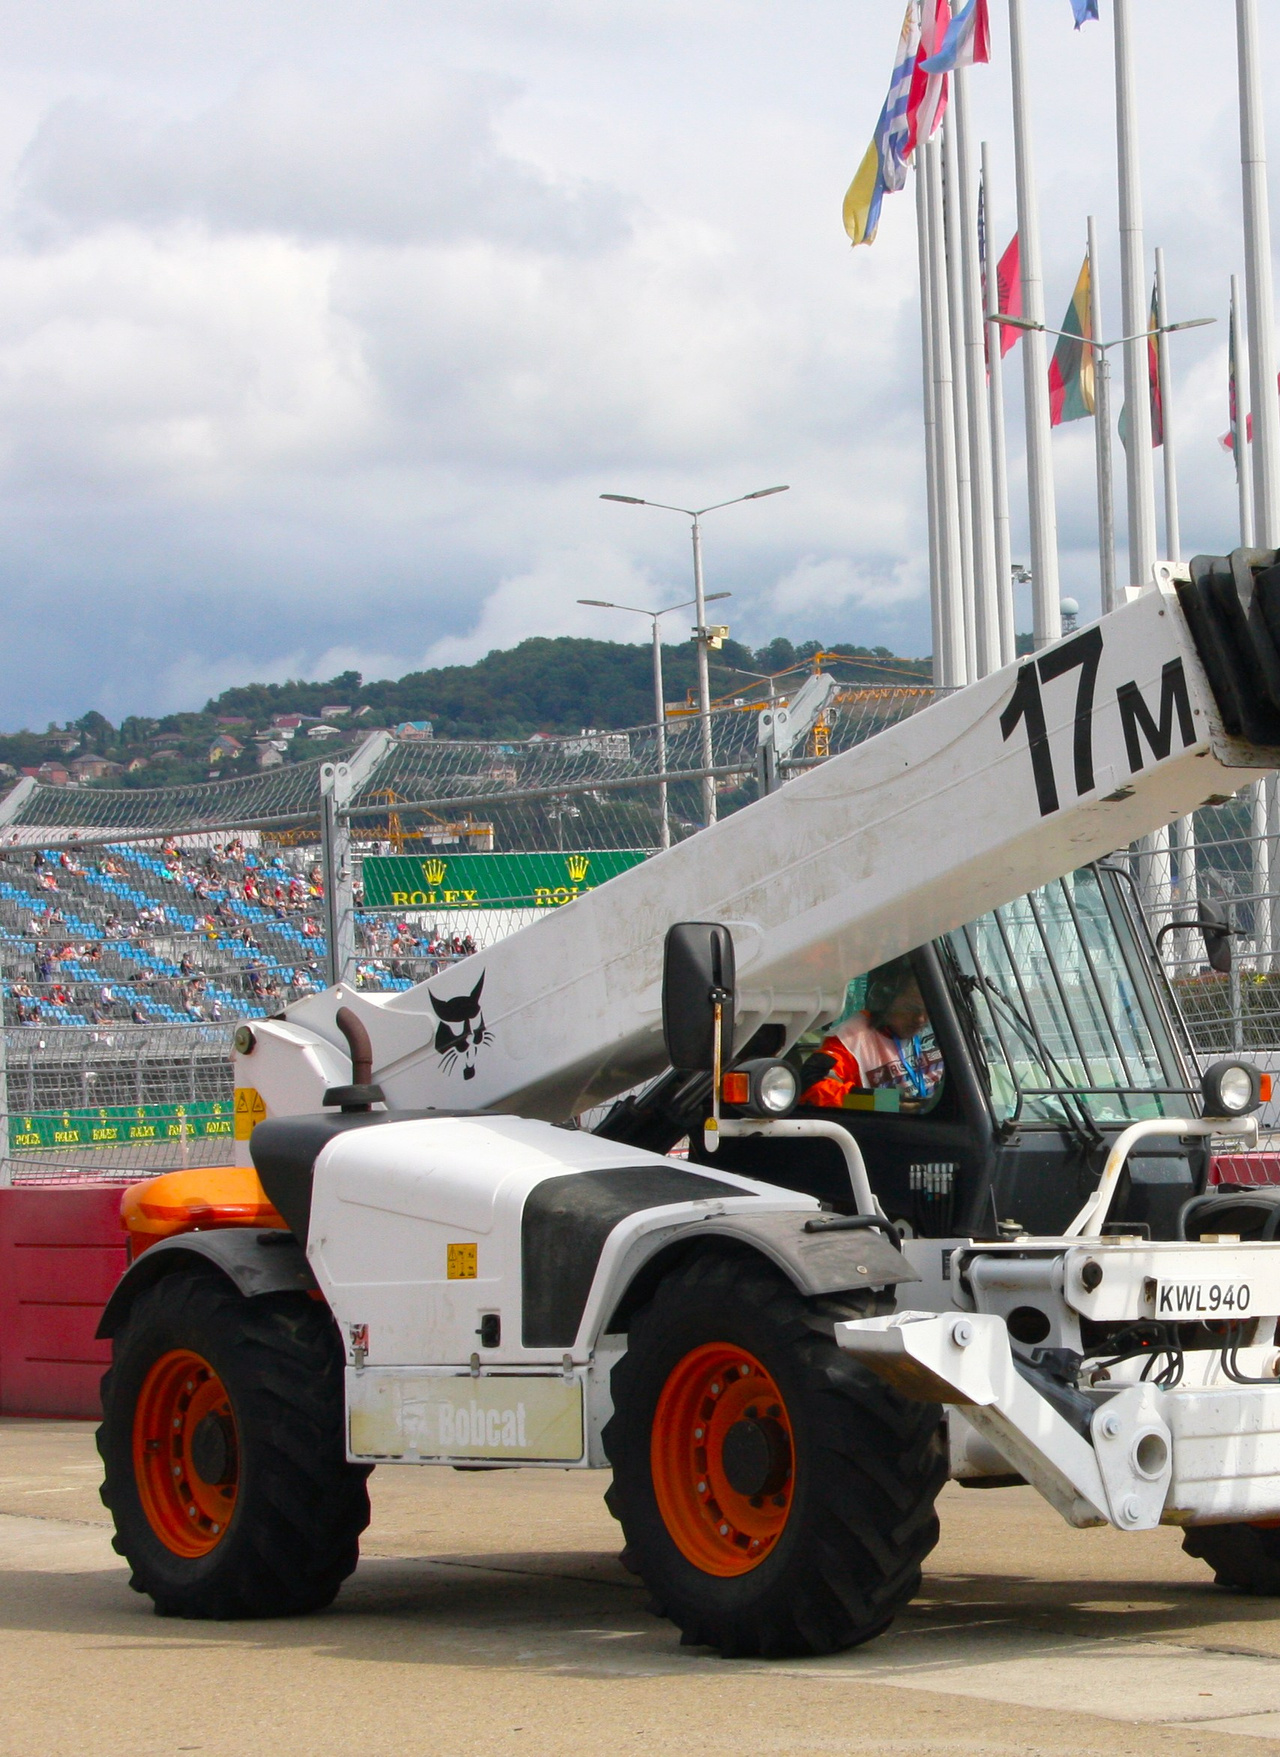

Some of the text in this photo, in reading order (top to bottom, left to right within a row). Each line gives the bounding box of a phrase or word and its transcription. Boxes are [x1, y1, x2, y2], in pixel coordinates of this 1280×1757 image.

[999, 625, 1197, 817] 17 M
[391, 886, 594, 907] ROLEX ROL
[1160, 1284, 1250, 1312] KWL940
[438, 1400, 528, 1448] Bobcat
